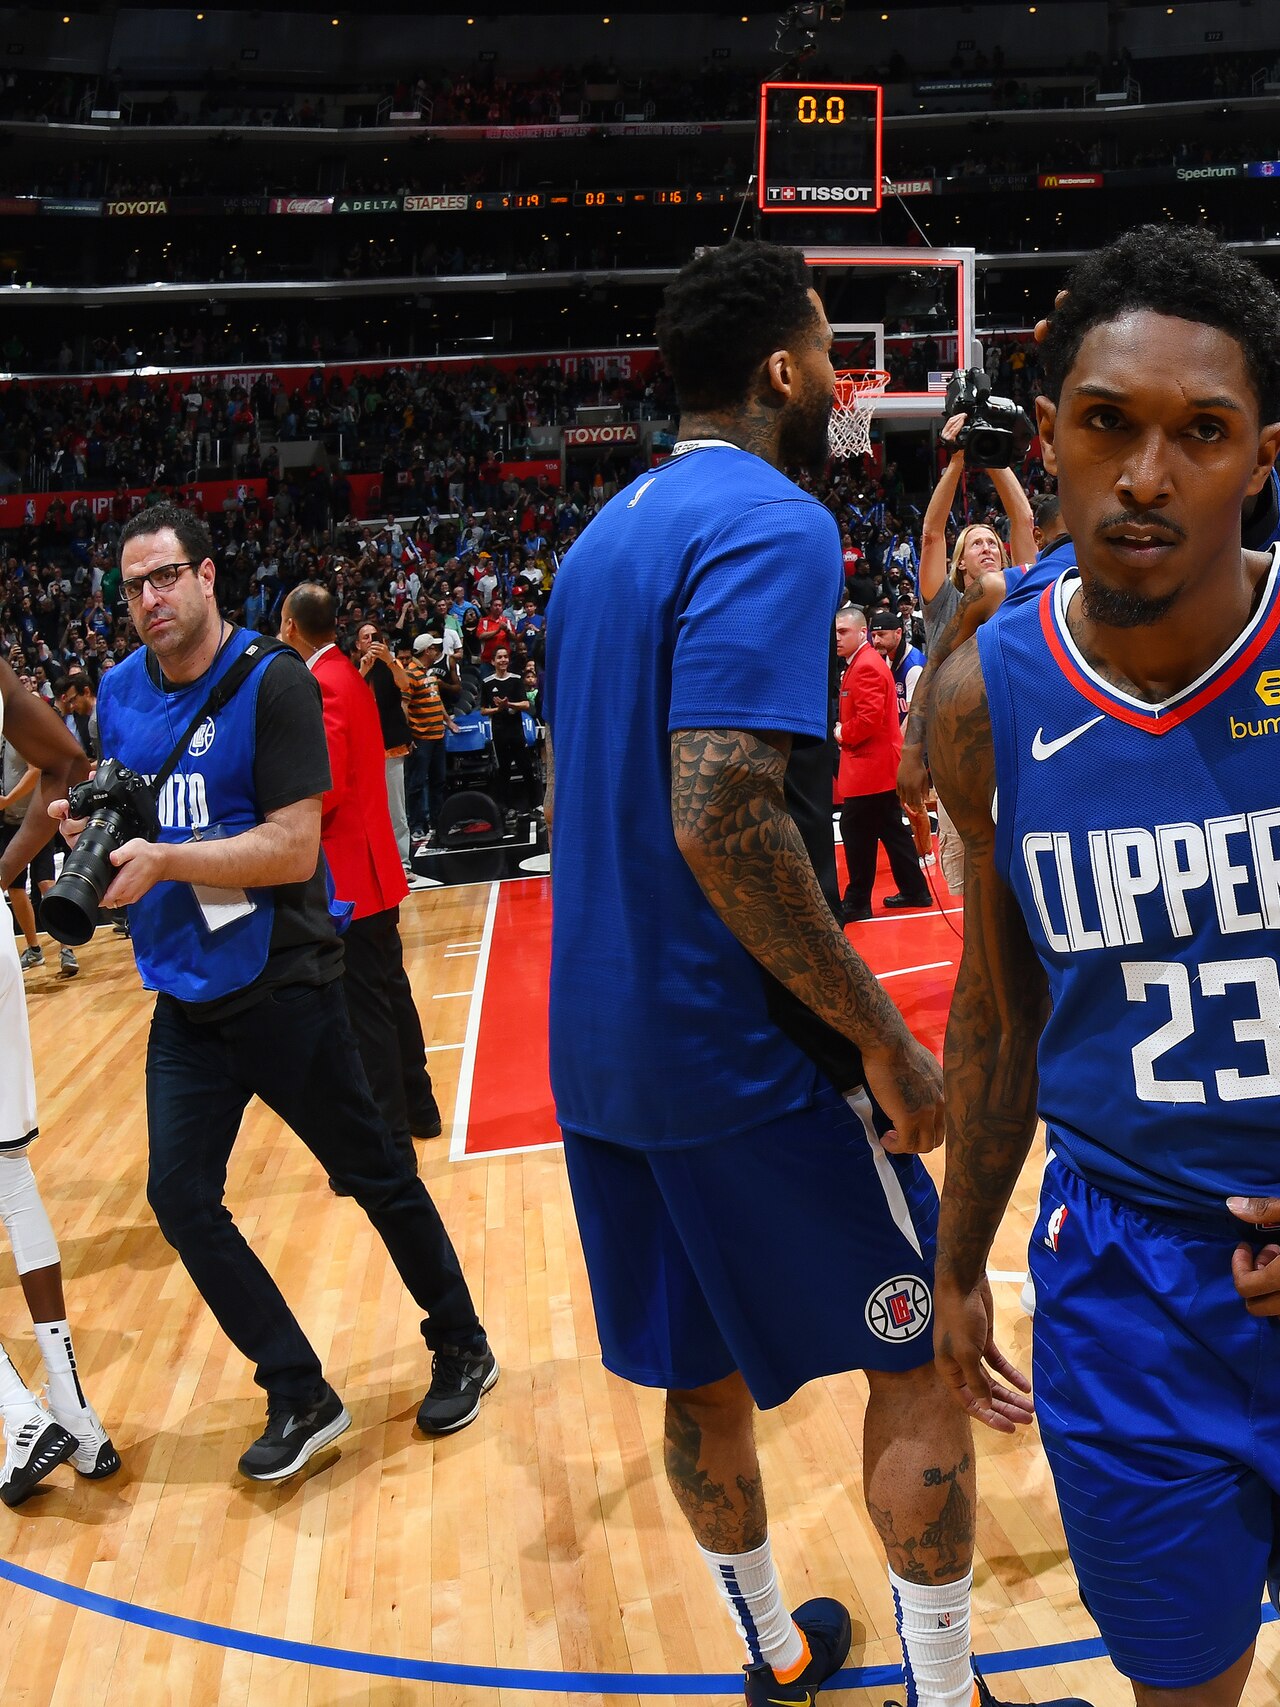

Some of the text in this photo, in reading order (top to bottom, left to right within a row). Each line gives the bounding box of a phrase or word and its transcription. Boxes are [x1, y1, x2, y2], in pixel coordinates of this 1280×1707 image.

[797, 95, 846, 124] 0.0
[1177, 166, 1236, 181] Spectrum
[518, 194, 540, 207] 119
[661, 190, 681, 203] 116
[797, 186, 873, 202] TISSOT
[106, 201, 168, 216] TOYOTA
[353, 200, 398, 211] DELTA
[404, 196, 465, 210] STAPLES
[564, 426, 636, 443] TOYOTA
